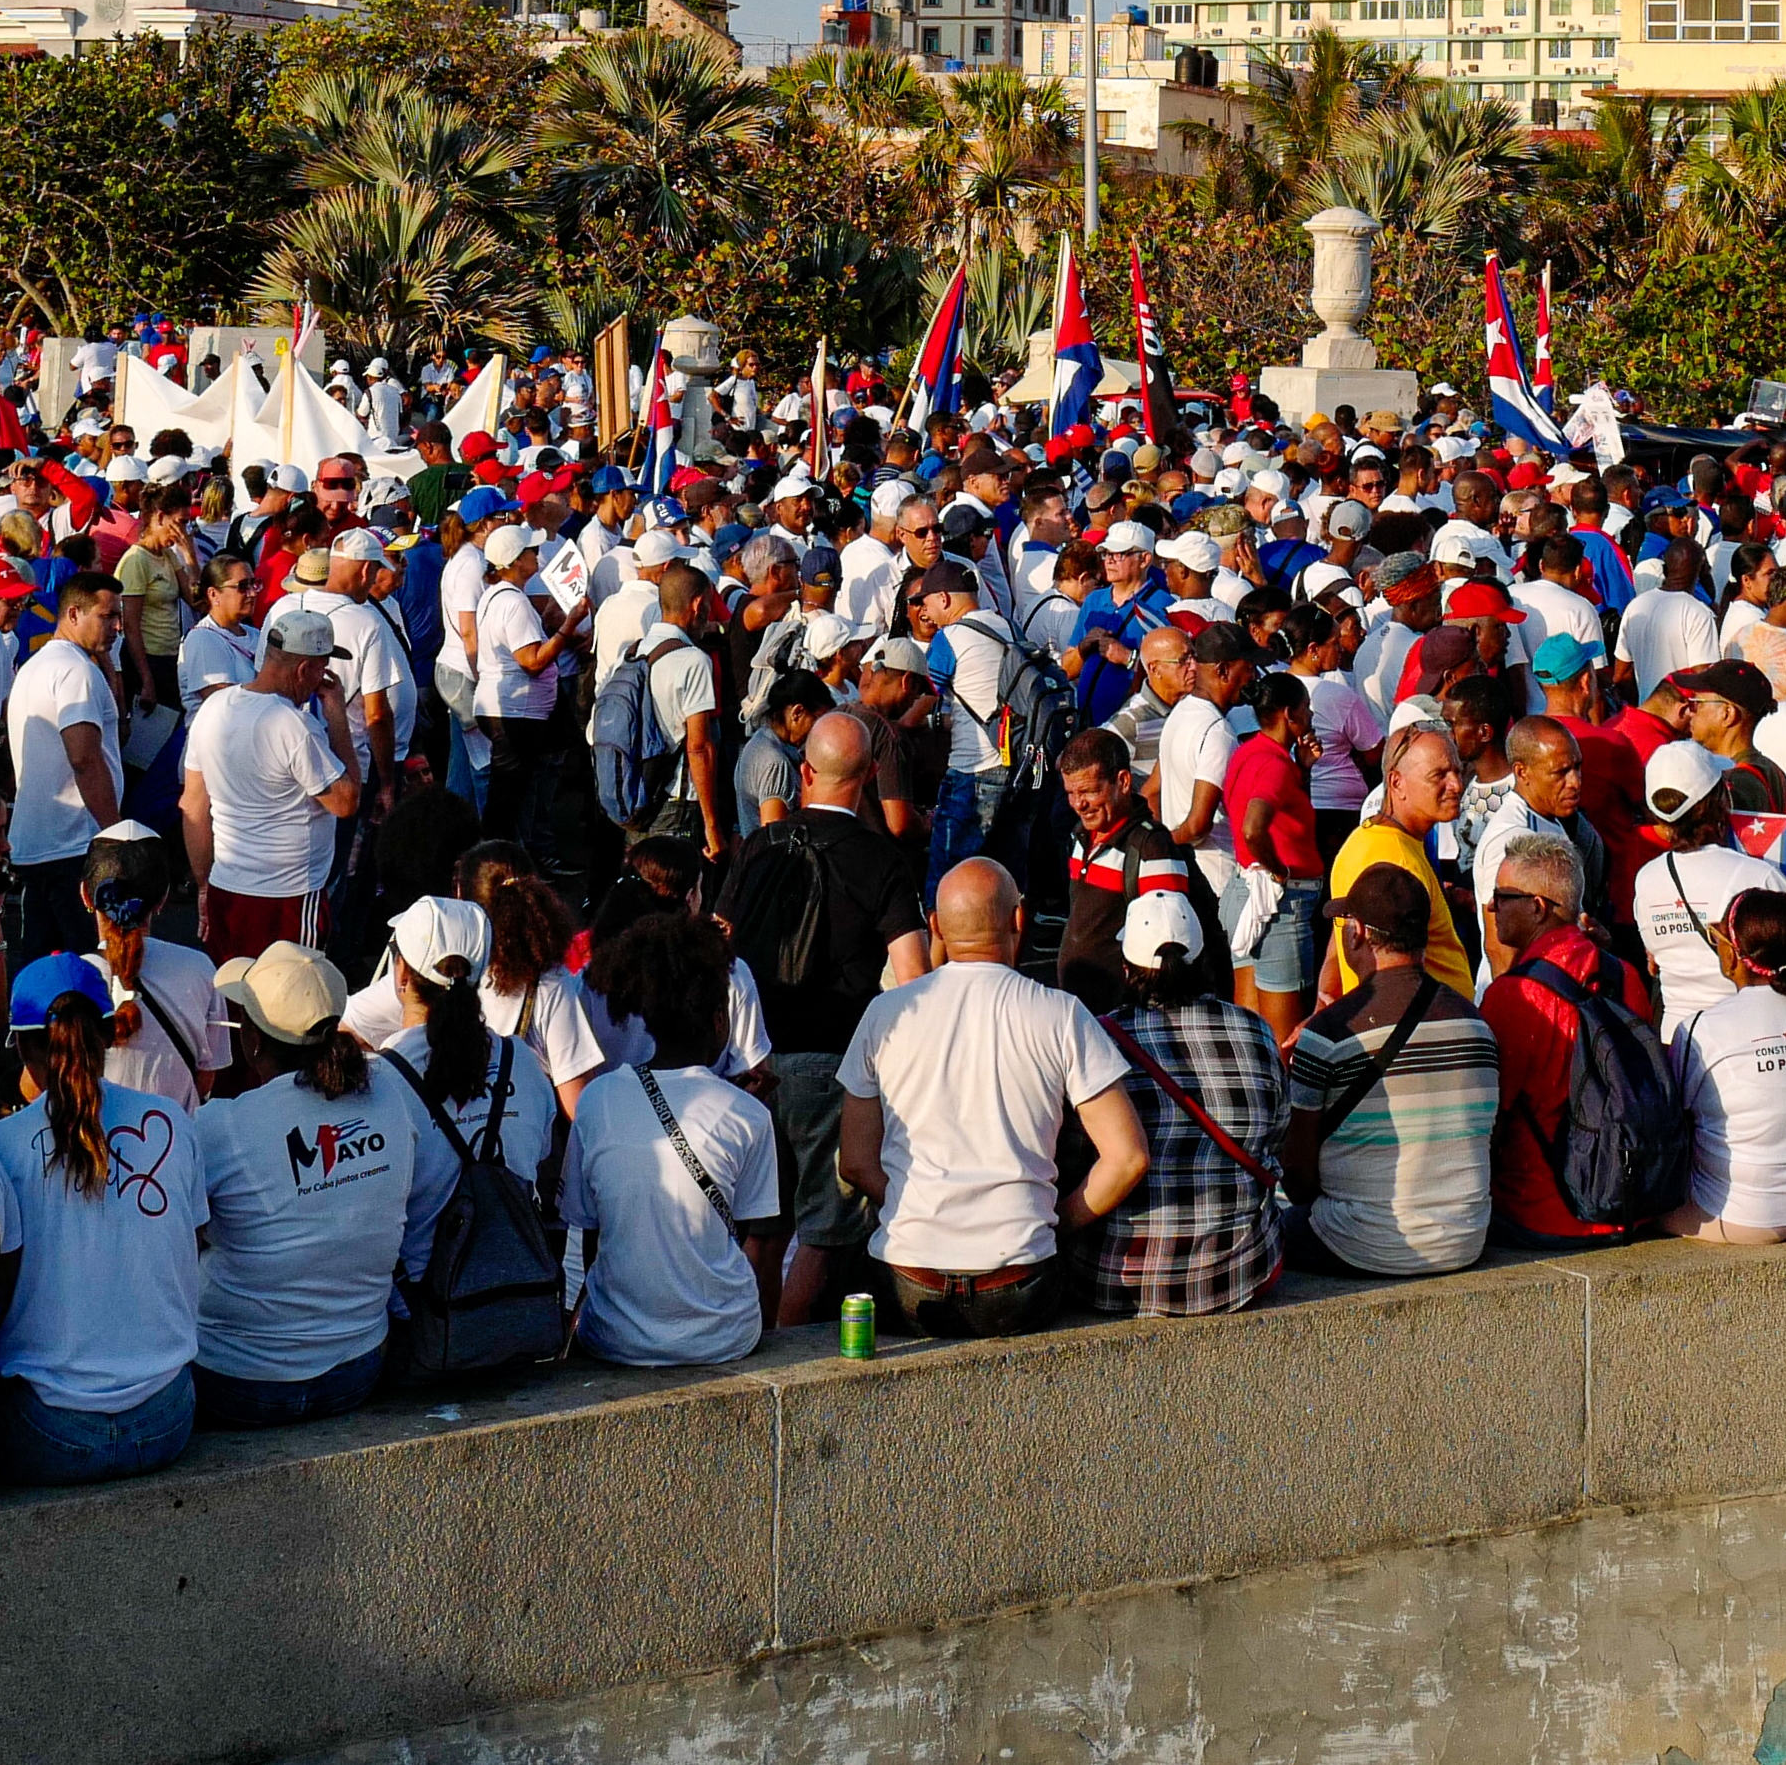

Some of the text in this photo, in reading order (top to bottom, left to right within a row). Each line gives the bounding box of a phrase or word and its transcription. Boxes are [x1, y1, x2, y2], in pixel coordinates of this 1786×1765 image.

[1655, 925, 1667, 935] LO
[1757, 1061, 1774, 1072] LO
[298, 1165, 390, 1196] Por Cuba juntos creamos
